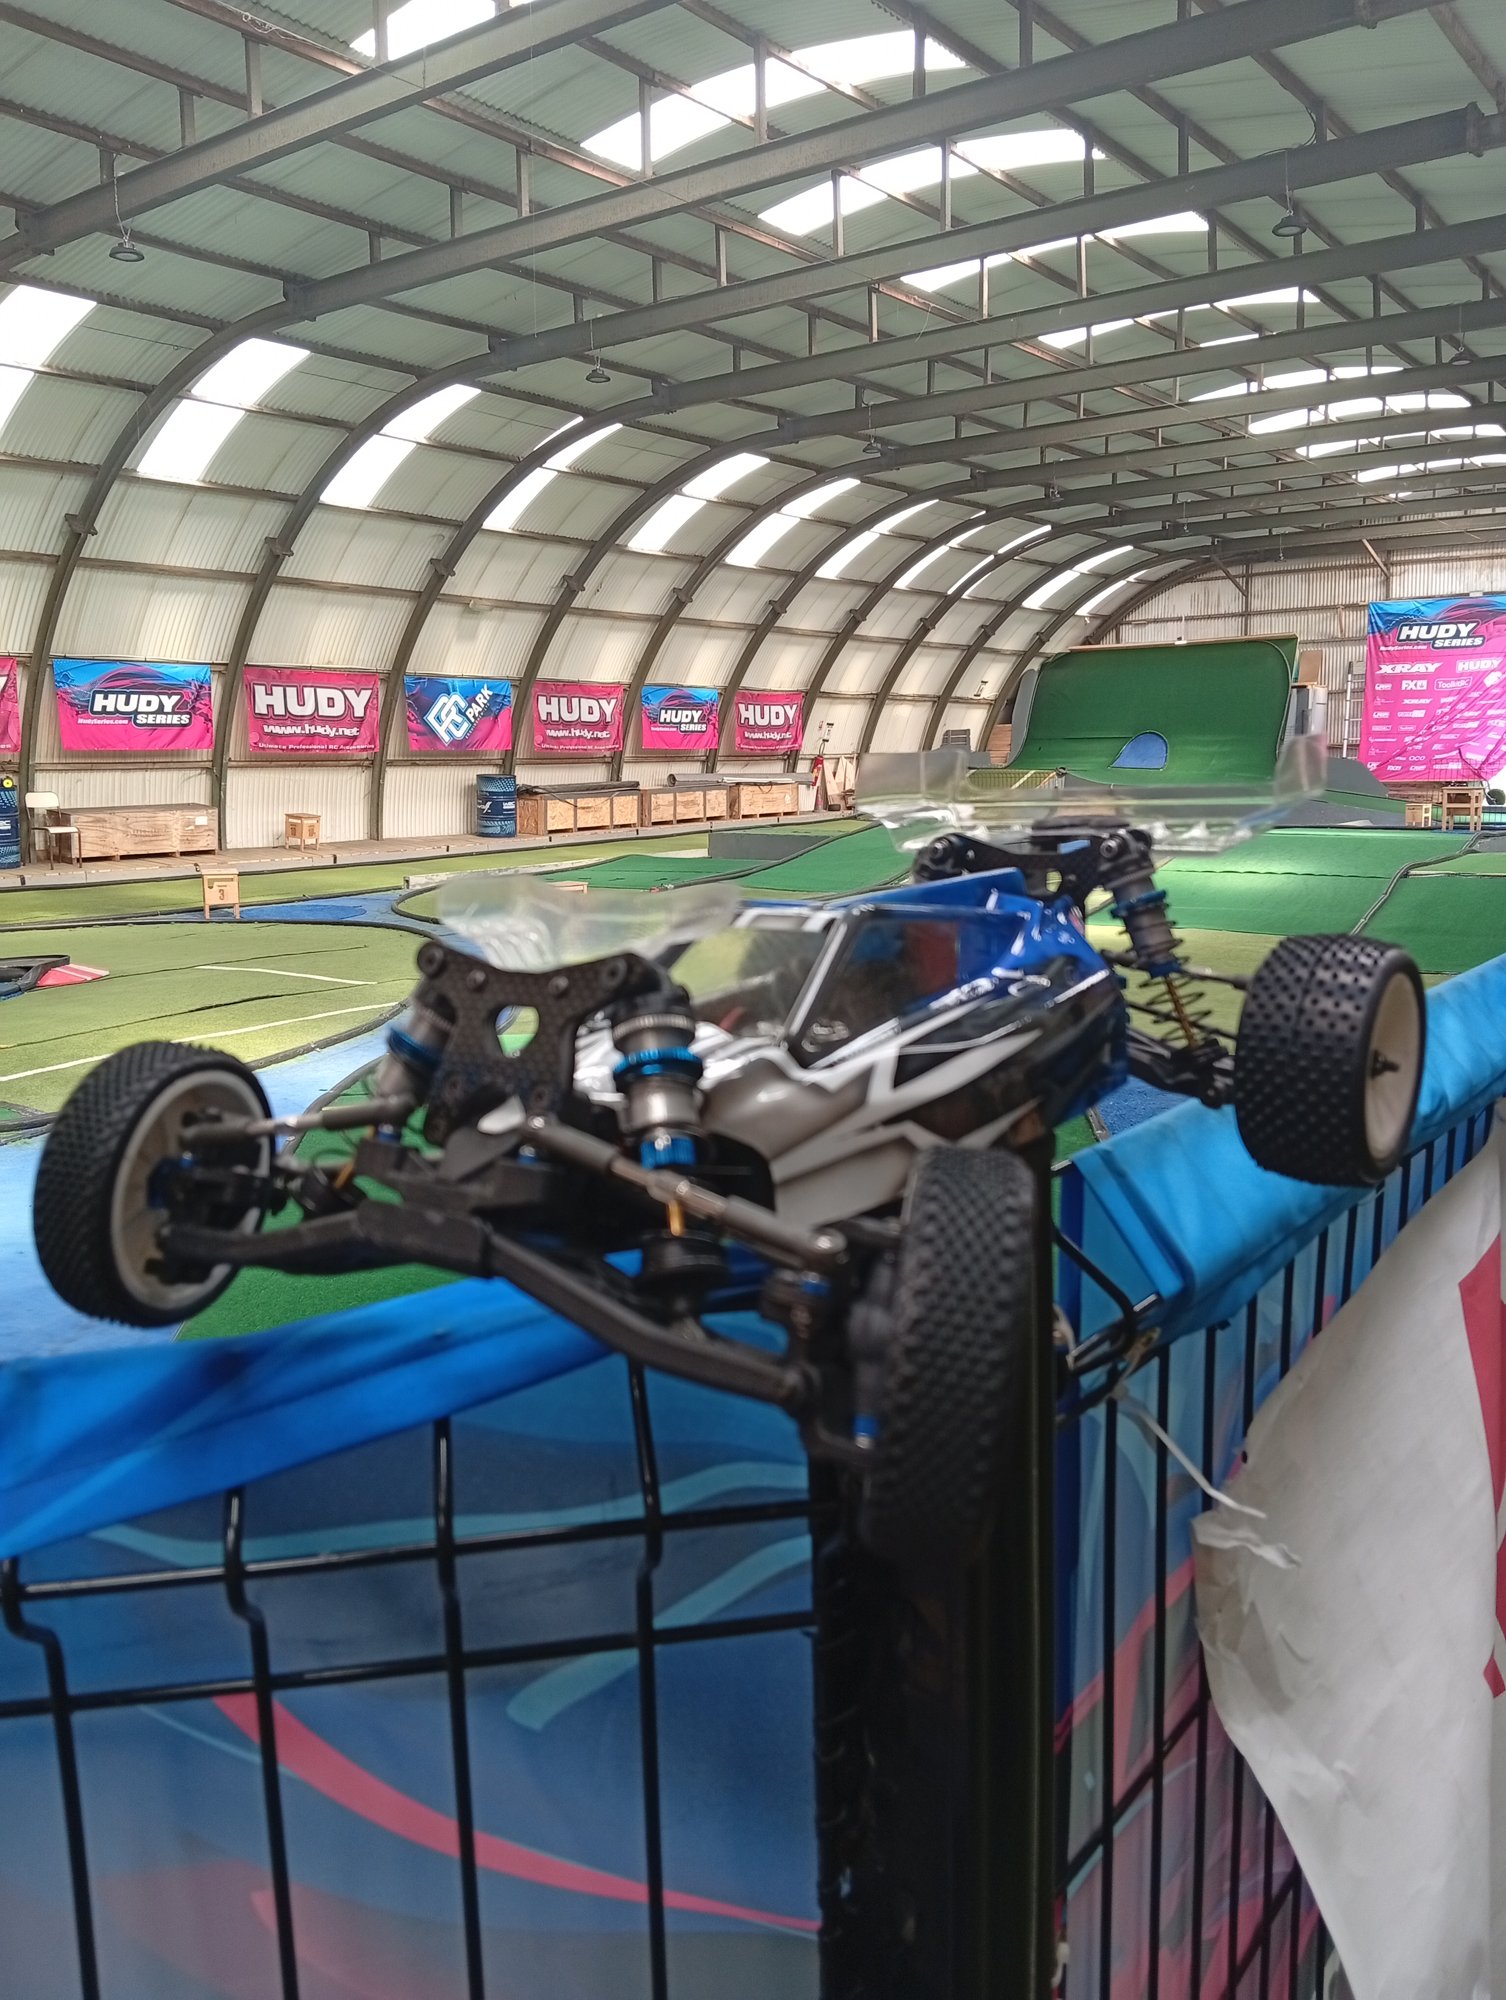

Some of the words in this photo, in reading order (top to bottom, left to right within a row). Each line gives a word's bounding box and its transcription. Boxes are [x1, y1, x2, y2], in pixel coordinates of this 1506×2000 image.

[1399, 622, 1478, 640] HUDY
[1433, 637, 1484, 648] SERIES
[1376, 662, 1443, 674] XRAY
[1457, 658, 1502, 672] HUDY
[93, 694, 181, 713] HUDY
[253, 684, 373, 718] HUDY
[465, 683, 493, 723] PARK
[537, 695, 617, 723] HUDY
[659, 709, 703, 723] HUDY
[738, 703, 798, 726] HUDY
[136, 713, 190, 725] SERIES
[263, 723, 360, 737] www.hudy.net
[545, 727, 610, 739] www.hudy.net
[680, 723, 707, 732] SERIES
[218, 888, 225, 901] 3
